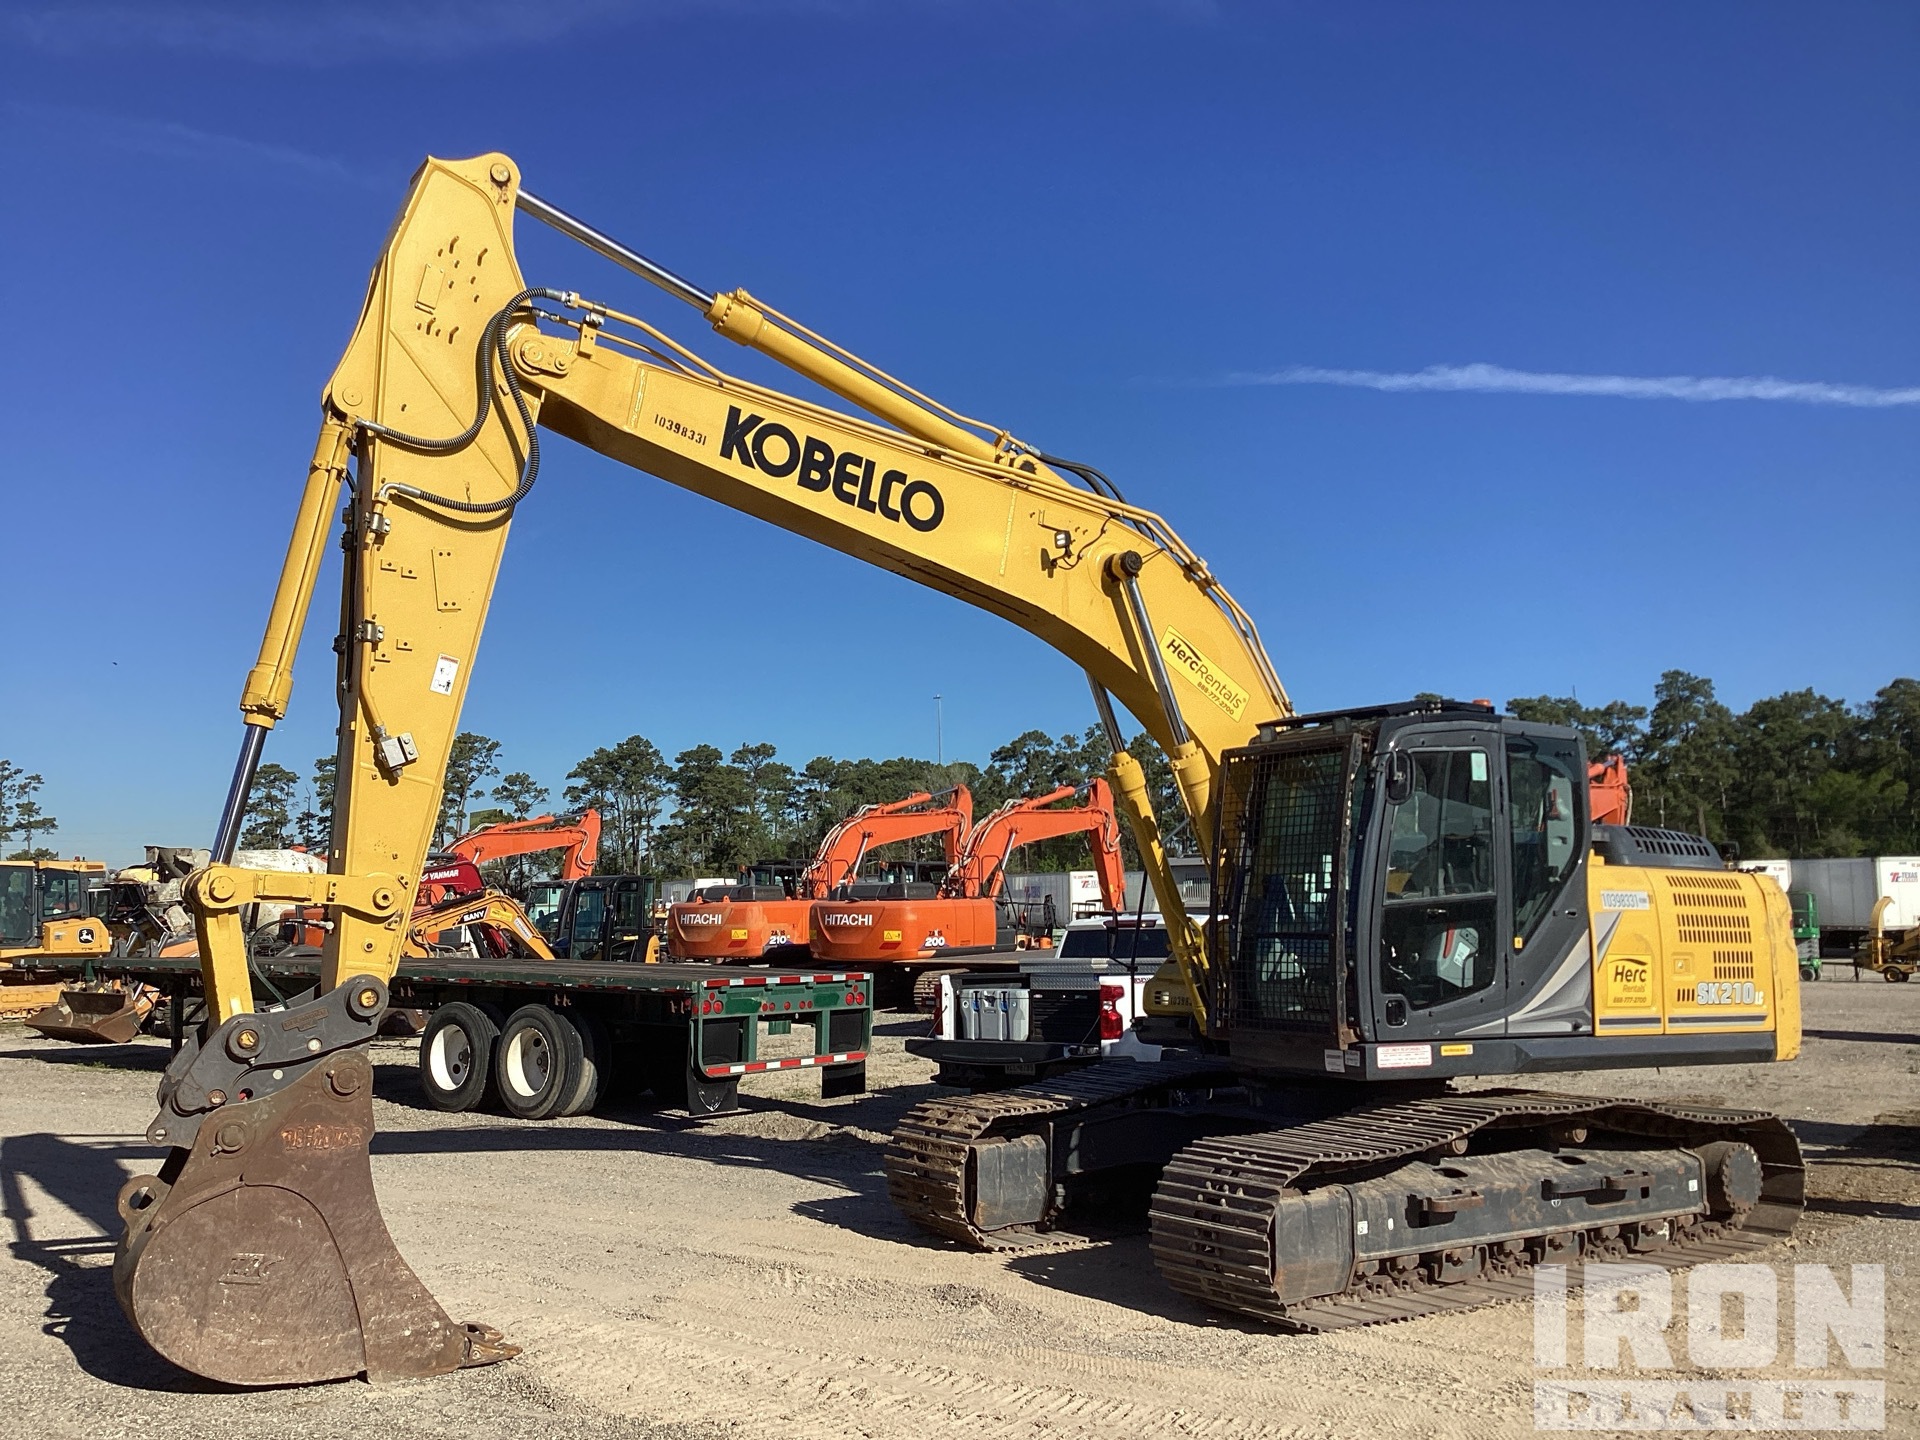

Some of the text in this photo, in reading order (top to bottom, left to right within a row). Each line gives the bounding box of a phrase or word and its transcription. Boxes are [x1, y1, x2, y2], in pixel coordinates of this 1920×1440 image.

[654, 413, 707, 446] 10398331
[720, 404, 945, 532] KOBELCO
[429, 869, 459, 880] YANMAR
[1602, 893, 1639, 908] 10398331
[463, 910, 485, 922] SANY
[680, 914, 722, 925] HITACHI
[824, 914, 873, 926] HITACHI
[769, 935, 787, 945] 210
[924, 936, 946, 947] 200
[1613, 965, 1647, 983] Herc
[1622, 984, 1646, 993] Rentals
[1696, 982, 1755, 1005] SK210
